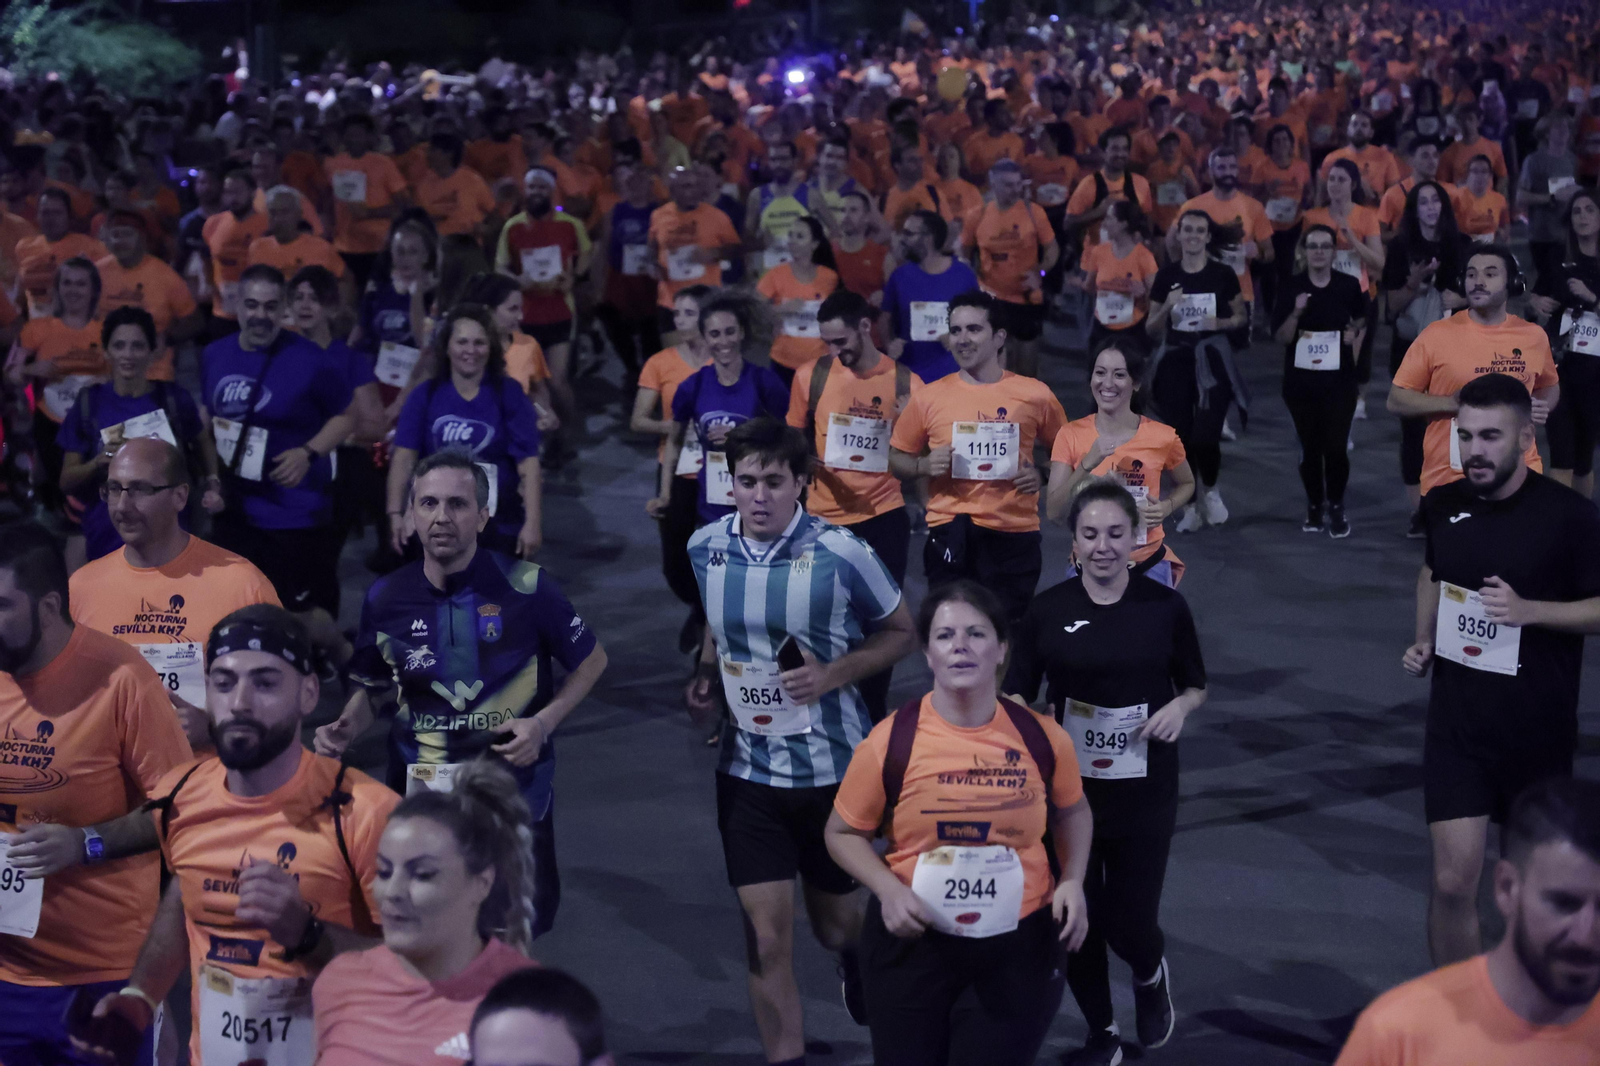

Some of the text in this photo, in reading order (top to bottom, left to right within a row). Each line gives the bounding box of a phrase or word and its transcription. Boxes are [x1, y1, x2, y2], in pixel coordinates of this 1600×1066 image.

[1307, 344, 1329, 354] 9353
[1475, 366, 1507, 374] SEVILLA
[842, 433, 879, 450] 17822
[968, 441, 1007, 456] 11115
[1122, 472, 1145, 480] TURNA
[134, 613, 187, 625] NOCTURNA
[112, 624, 156, 635] SEVILLA
[1457, 614, 1497, 640] 9350
[740, 686, 783, 706] 3654
[1085, 729, 1127, 750] 9349
[966, 768, 1027, 777] NOCTURNA
[937, 775, 993, 788] SEVILLA
[944, 878, 997, 900] 2944
[221, 1011, 292, 1044] 20517
